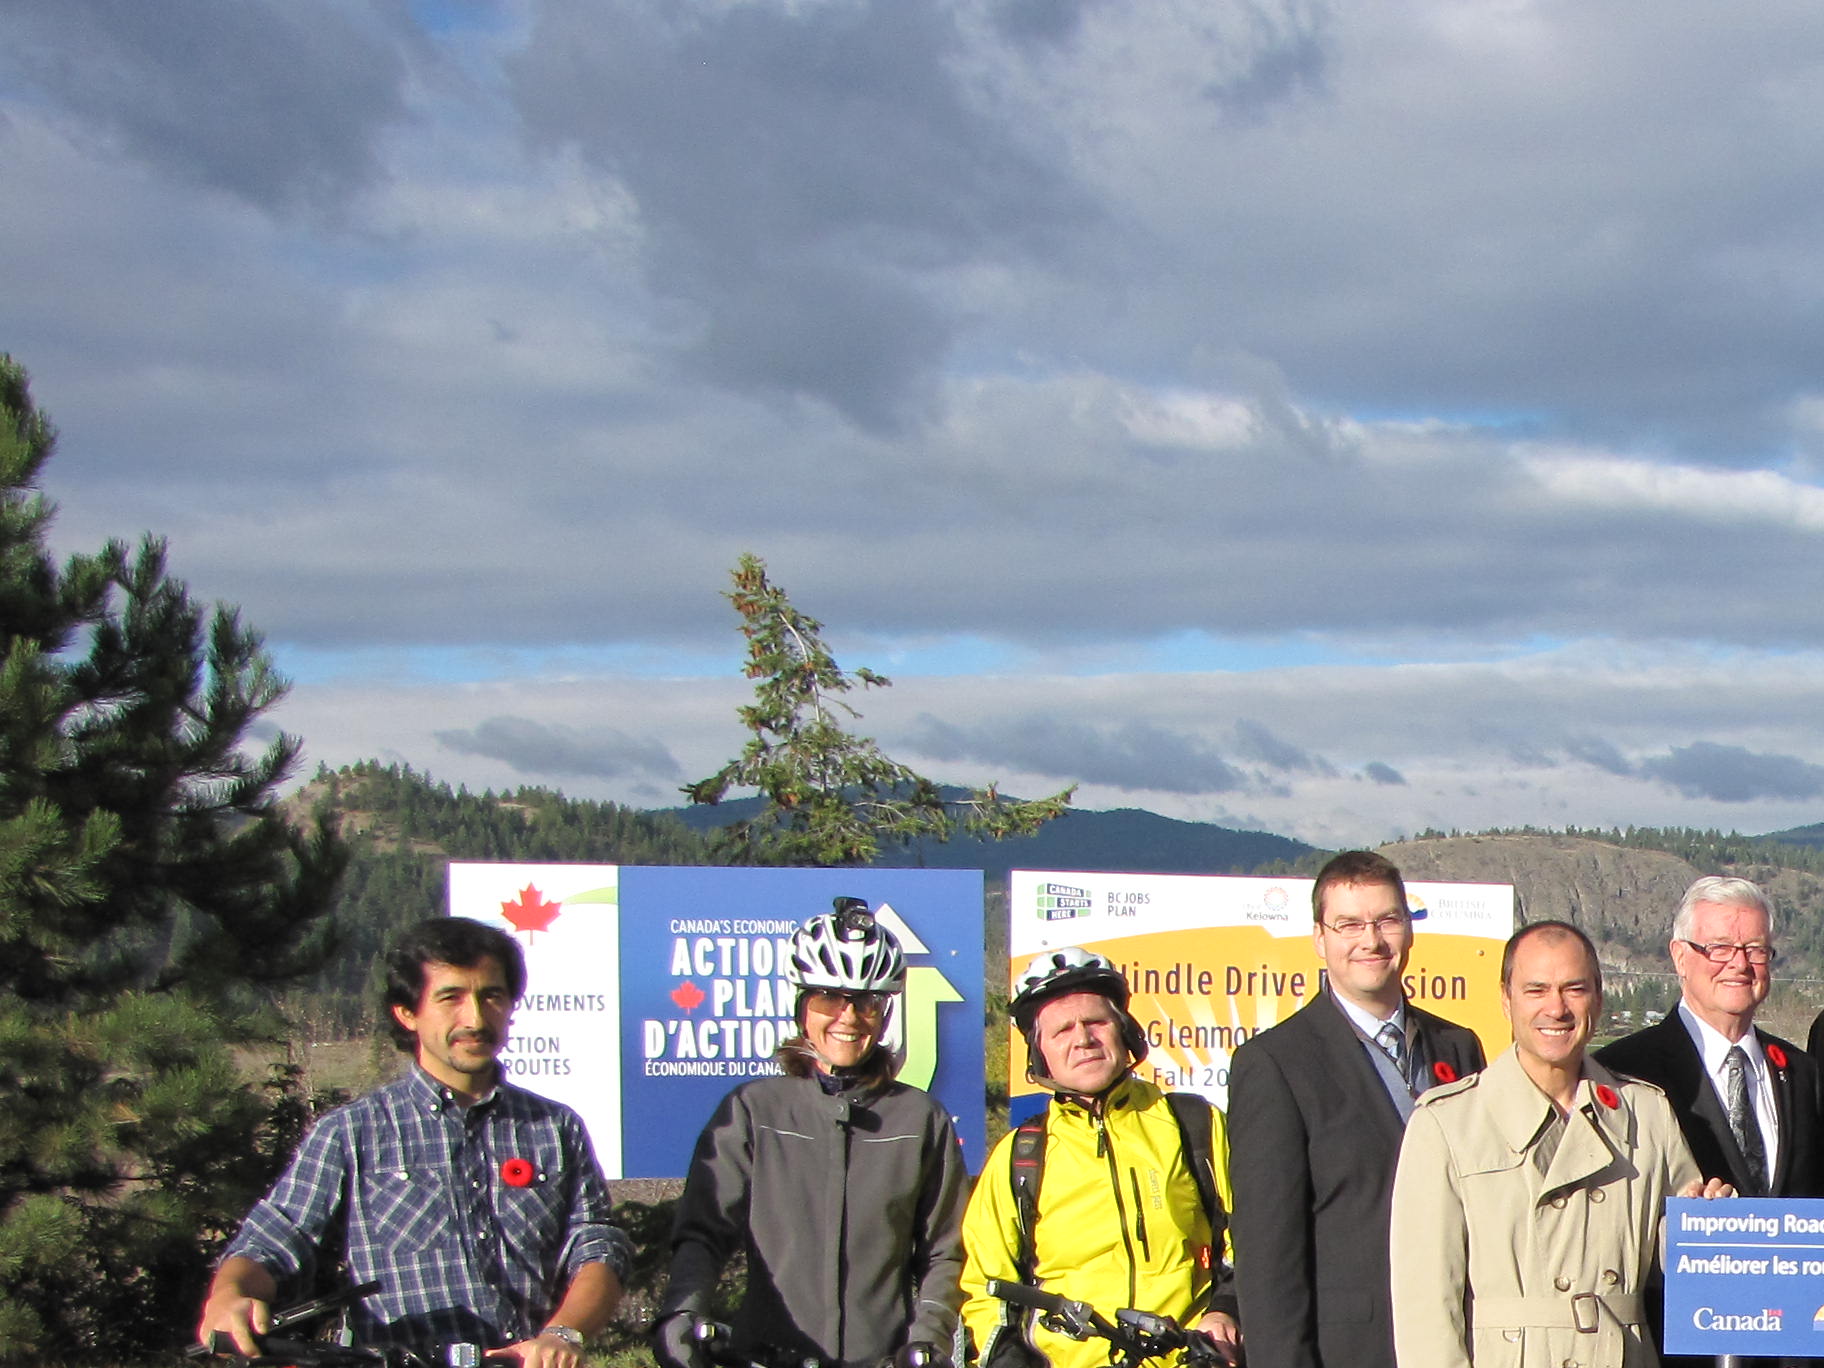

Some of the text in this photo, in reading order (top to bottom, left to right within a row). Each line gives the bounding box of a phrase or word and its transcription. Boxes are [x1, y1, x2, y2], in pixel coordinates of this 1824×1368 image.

[1124, 892, 1151, 905] JOBS
[1108, 905, 1137, 917] PLAN
[1246, 911, 1289, 921] Kelowna
[670, 919, 799, 935] CANADA'S ECONOMIC
[1226, 964, 1305, 997] Drive
[713, 978, 797, 1018] PLAN
[503, 1058, 572, 1076] ROUTES
[645, 1058, 787, 1077] ÉCONOMIQUE DU CANA
[1153, 1066, 1194, 1087] Fall
[1680, 1211, 1780, 1238] Improving
[1676, 1254, 1770, 1275] Améliorer
[1772, 1255, 1799, 1276] les
[1692, 1306, 1783, 1332] Canada
